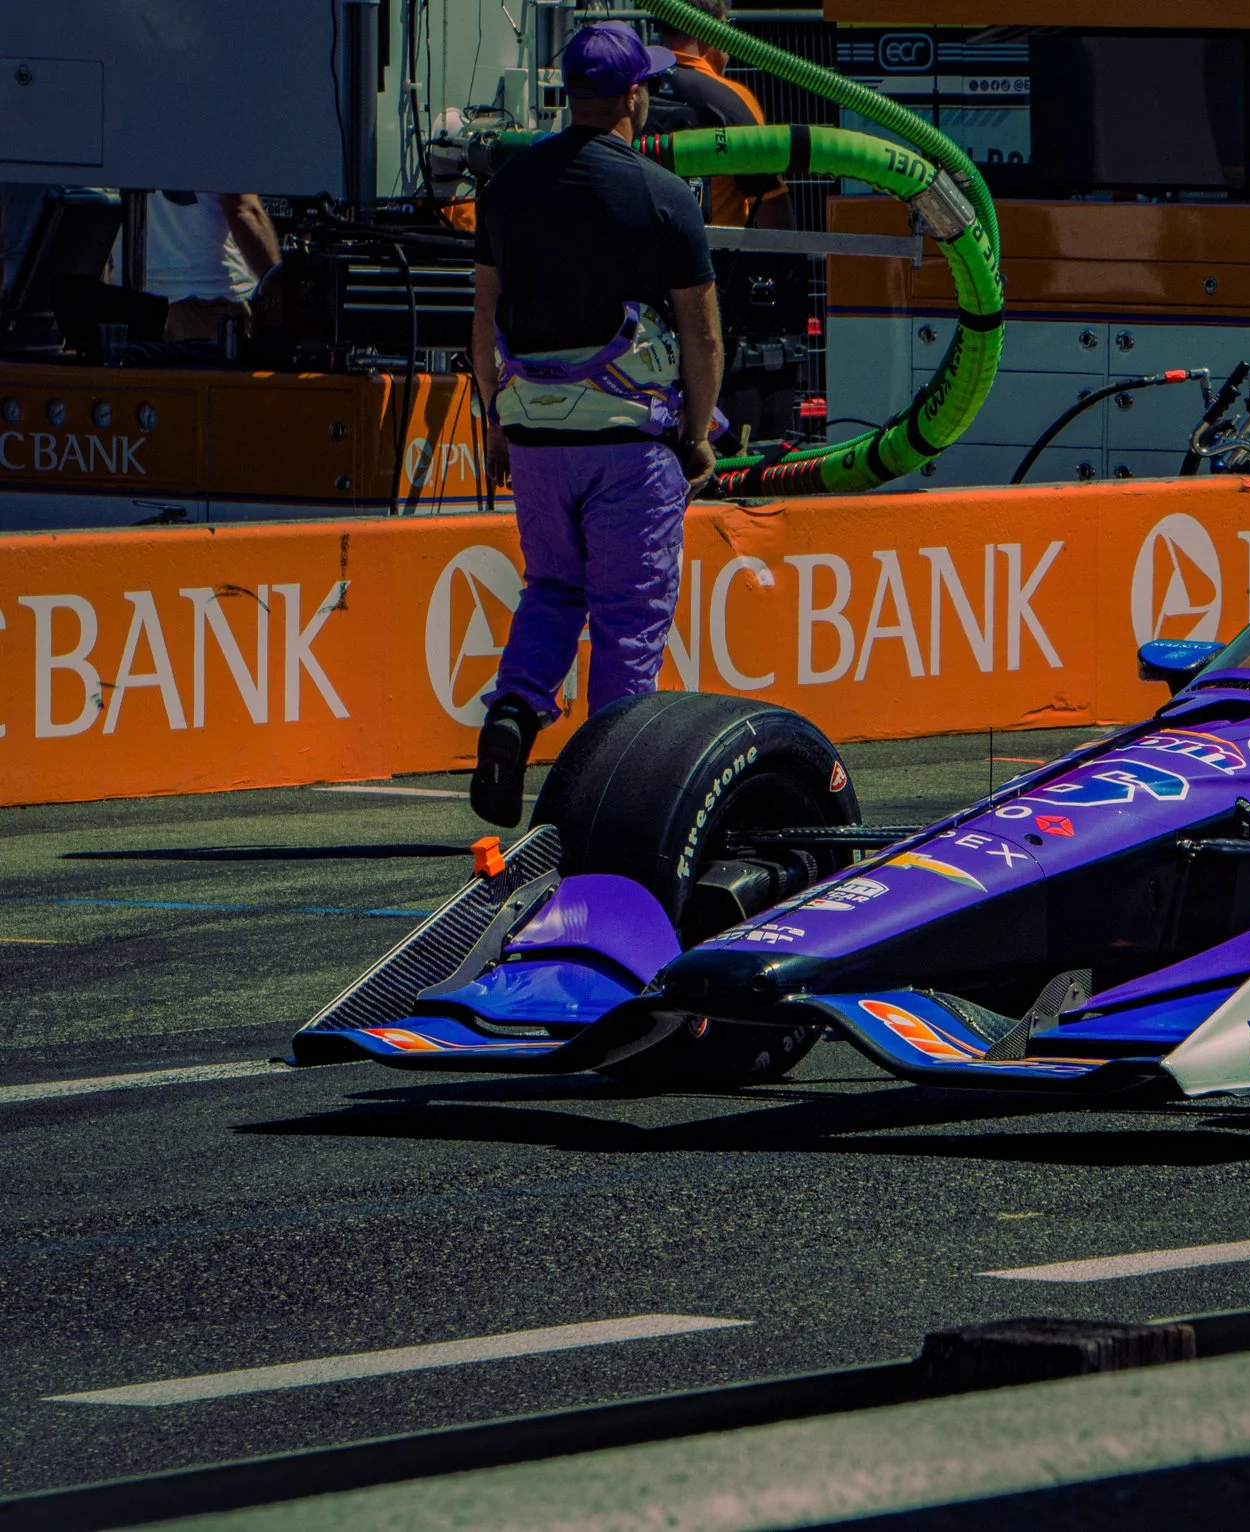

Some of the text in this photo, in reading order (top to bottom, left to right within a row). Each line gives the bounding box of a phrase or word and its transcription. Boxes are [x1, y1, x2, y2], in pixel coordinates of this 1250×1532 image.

[29, 432, 147, 475] BANK
[18, 580, 352, 740] BANK
[783, 541, 1065, 686] BANK
[677, 745, 758, 880] Firestone
